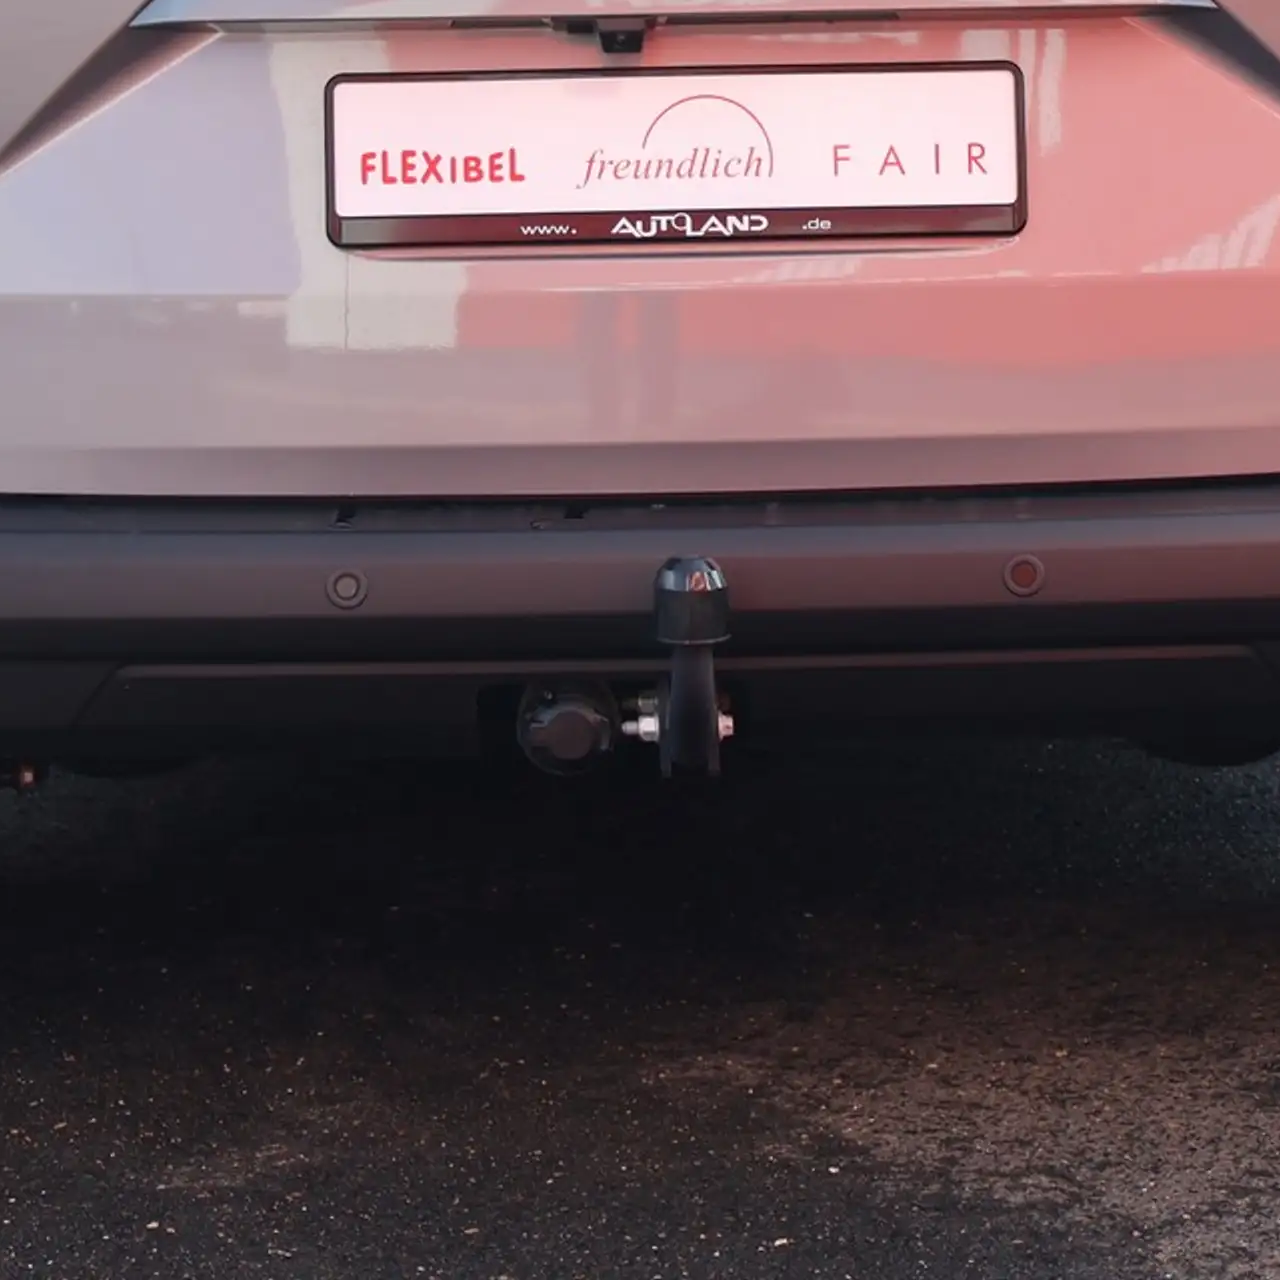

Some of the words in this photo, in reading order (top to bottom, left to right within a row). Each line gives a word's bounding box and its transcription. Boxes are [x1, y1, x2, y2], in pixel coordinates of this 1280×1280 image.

[360, 148, 526, 186] FLEXIBEL
[575, 147, 764, 190] freundlich
[832, 142, 988, 177] FAIR
[519, 225, 578, 236] www.
[610, 212, 769, 238] AUTOLAND
[801, 217, 832, 231] .de
